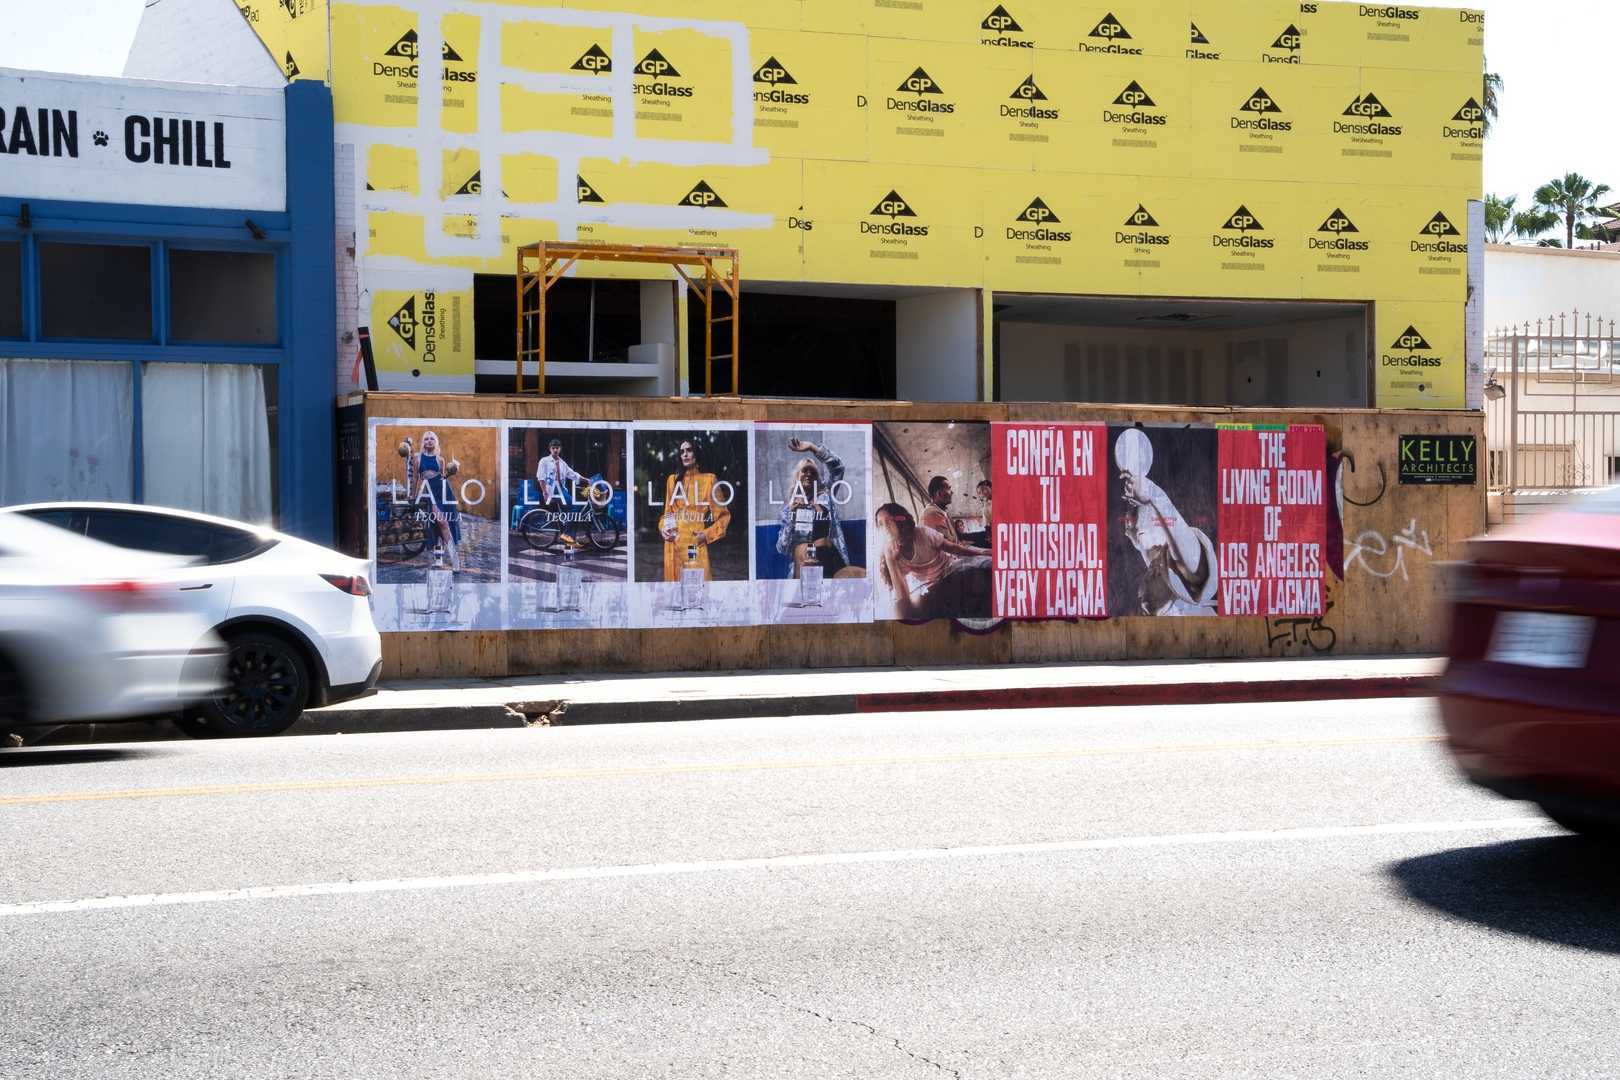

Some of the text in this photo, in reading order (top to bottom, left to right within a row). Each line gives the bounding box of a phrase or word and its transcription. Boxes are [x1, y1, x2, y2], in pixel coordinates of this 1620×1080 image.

[1359, 5, 1419, 19] DensGlass
[987, 15, 1012, 29] GP
[1097, 23, 1121, 37] GP
[582, 55, 609, 69] GP
[641, 60, 668, 74] GP
[759, 67, 785, 81] GP
[907, 78, 932, 91] GP
[1122, 91, 1145, 103] GP
[1248, 97, 1272, 110] GP
[887, 98, 954, 113] DensGlass
[1103, 110, 1166, 125] DensGlass
[1461, 107, 1482, 119] GP
[1230, 117, 1291, 131] DensGlass
[0, 106, 231, 168] AIN CHILL
[689, 191, 715, 205] GP
[880, 201, 905, 214] GP
[1026, 207, 1050, 220] GP
[860, 221, 928, 235] DensGlass
[1231, 215, 1254, 228] GP
[1326, 218, 1349, 231] GP
[1428, 221, 1450, 234] GP
[1006, 227, 1071, 241] DensGlass
[1213, 235, 1274, 248] DensGlass
[1309, 237, 1368, 250] DensGlass
[400, 308, 413, 338] GP
[1400, 336, 1421, 348] GP
[1382, 354, 1441, 367] DensGlass
[1007, 427, 1094, 476] CONFÍA EN
[1259, 432, 1286, 468] THE
[1402, 439, 1474, 461] KELLY
[1402, 463, 1474, 473] ARCHITECTS
[392, 478, 486, 506] LALO
[523, 479, 614, 506] LALO
[647, 480, 735, 506] LALO
[769, 480, 852, 505] LALO
[1222, 468, 1322, 505] LIVING ROOM
[1040, 476, 1061, 522] TU
[415, 511, 463, 522] TEQUILA
[545, 511, 592, 522] TEQUILA
[1263, 506, 1281, 541] OF
[996, 523, 1103, 569] CURIOSIDAD.
[1220, 542, 1248, 578] LOS
[1255, 543, 1324, 578] ANGELES.
[994, 569, 1106, 616] VERY LACMA
[1222, 579, 1322, 615] VERY LACMA
